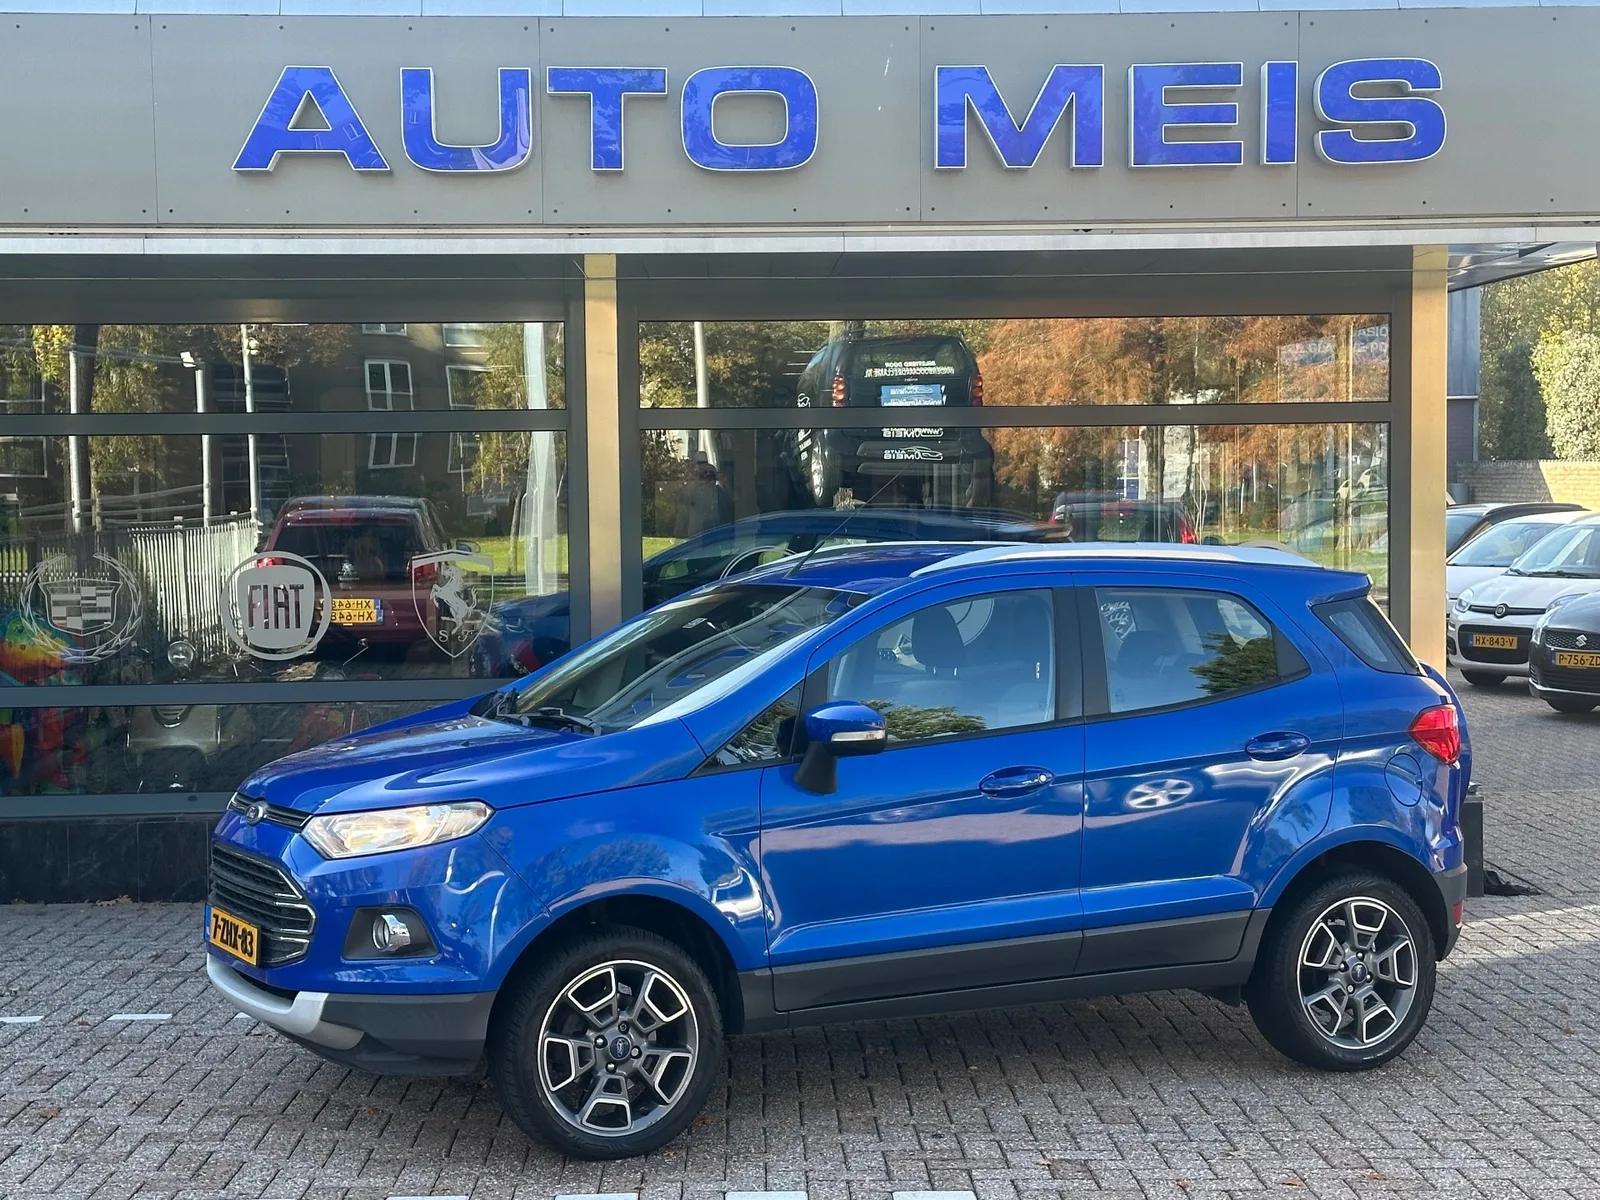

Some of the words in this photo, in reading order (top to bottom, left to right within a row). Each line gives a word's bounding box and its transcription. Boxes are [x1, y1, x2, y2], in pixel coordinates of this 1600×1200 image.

[231, 64, 819, 173] AUTO
[933, 57, 1447, 170] MEIS
[247, 584, 304, 629] FIAT
[439, 629, 448, 642] S
[1475, 634, 1515, 648] HX-843-V
[1558, 653, 1600, 667] P-756-ZD
[212, 913, 254, 958] 7-ZHX-83
